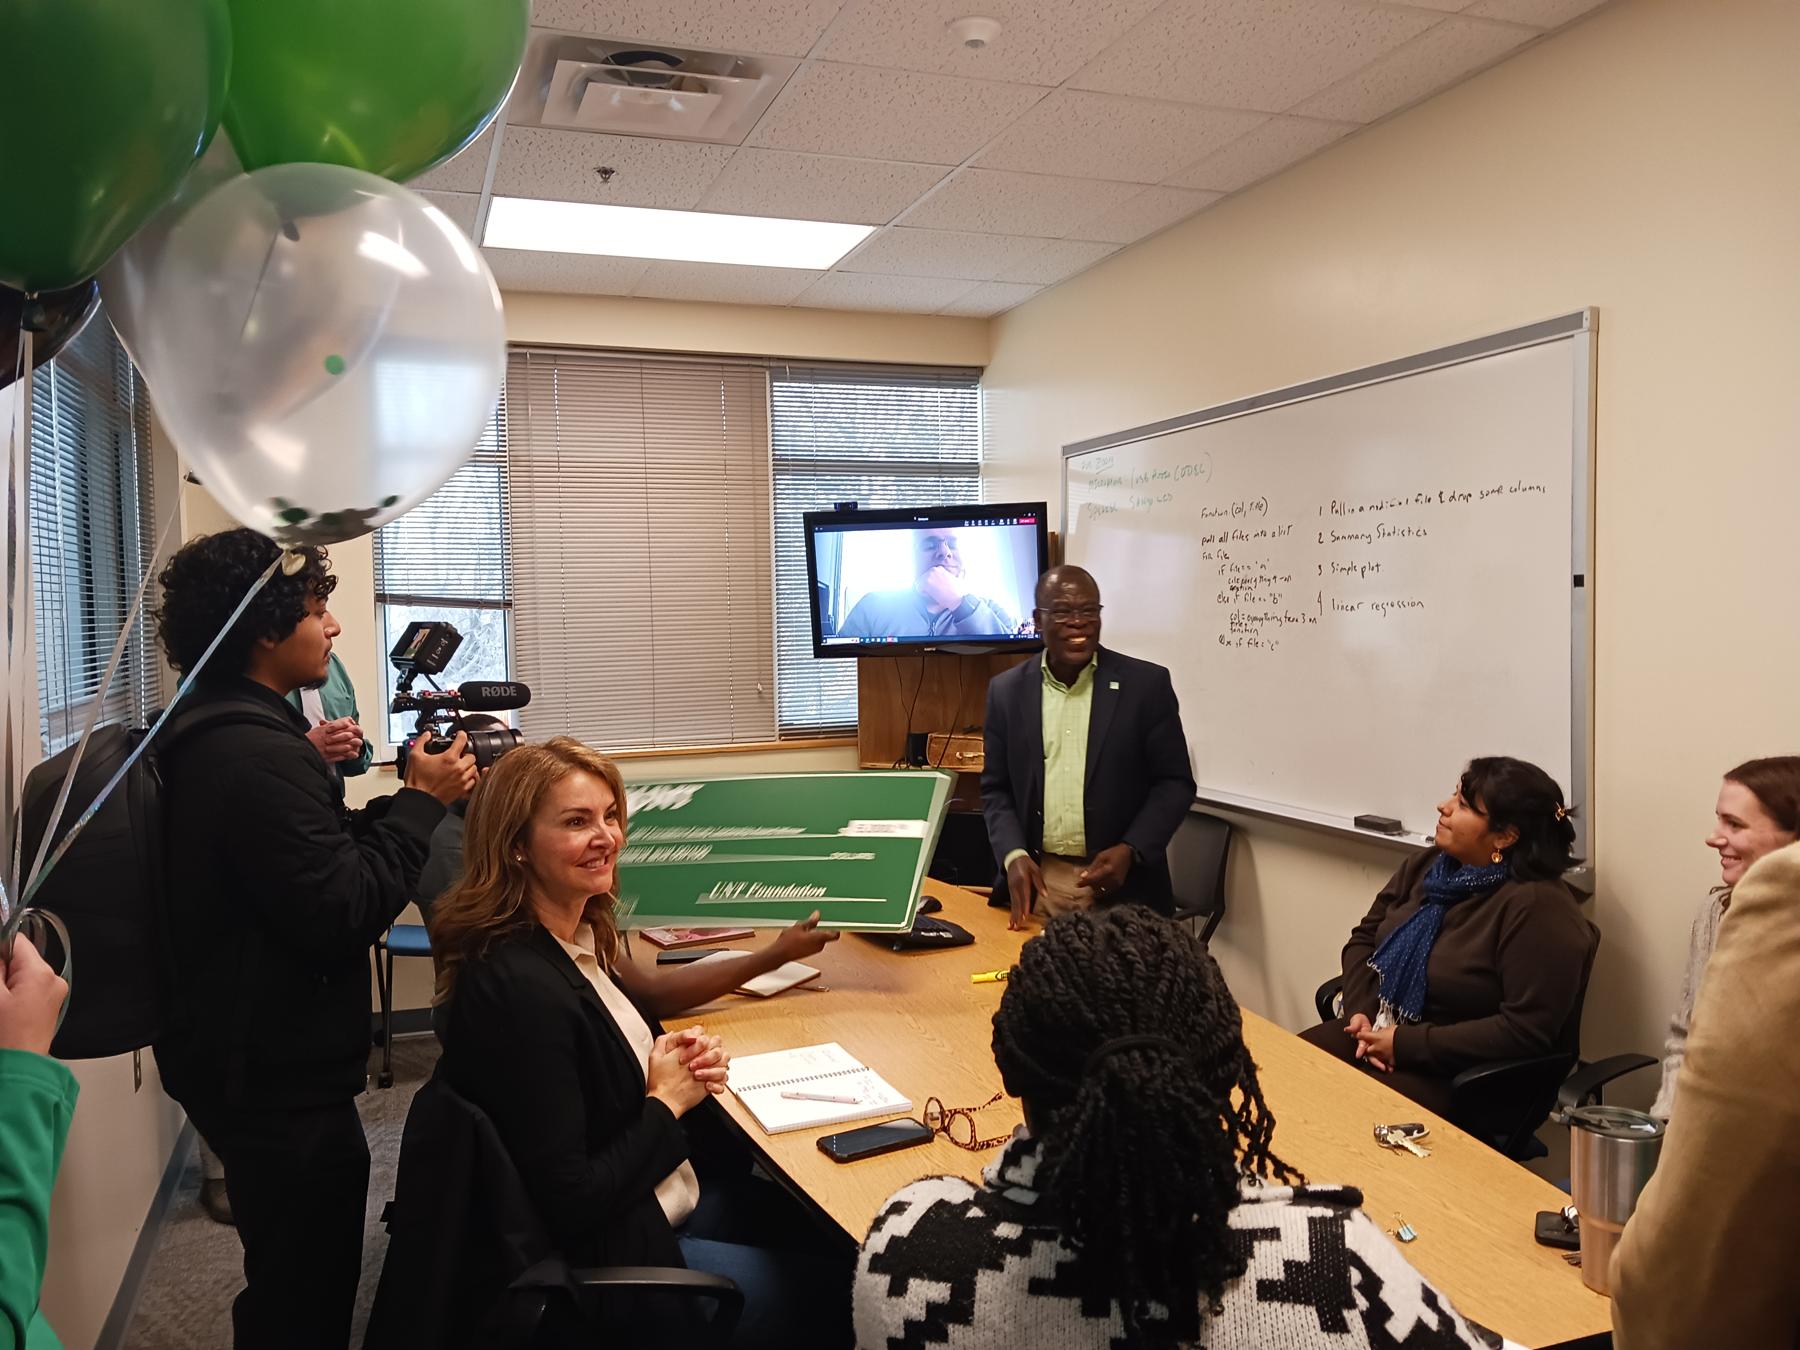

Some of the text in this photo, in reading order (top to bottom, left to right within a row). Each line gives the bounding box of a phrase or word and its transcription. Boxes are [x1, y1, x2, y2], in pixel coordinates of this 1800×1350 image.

[1317, 531, 1324, 544] 2
[708, 881, 828, 899] UNT Foundation
